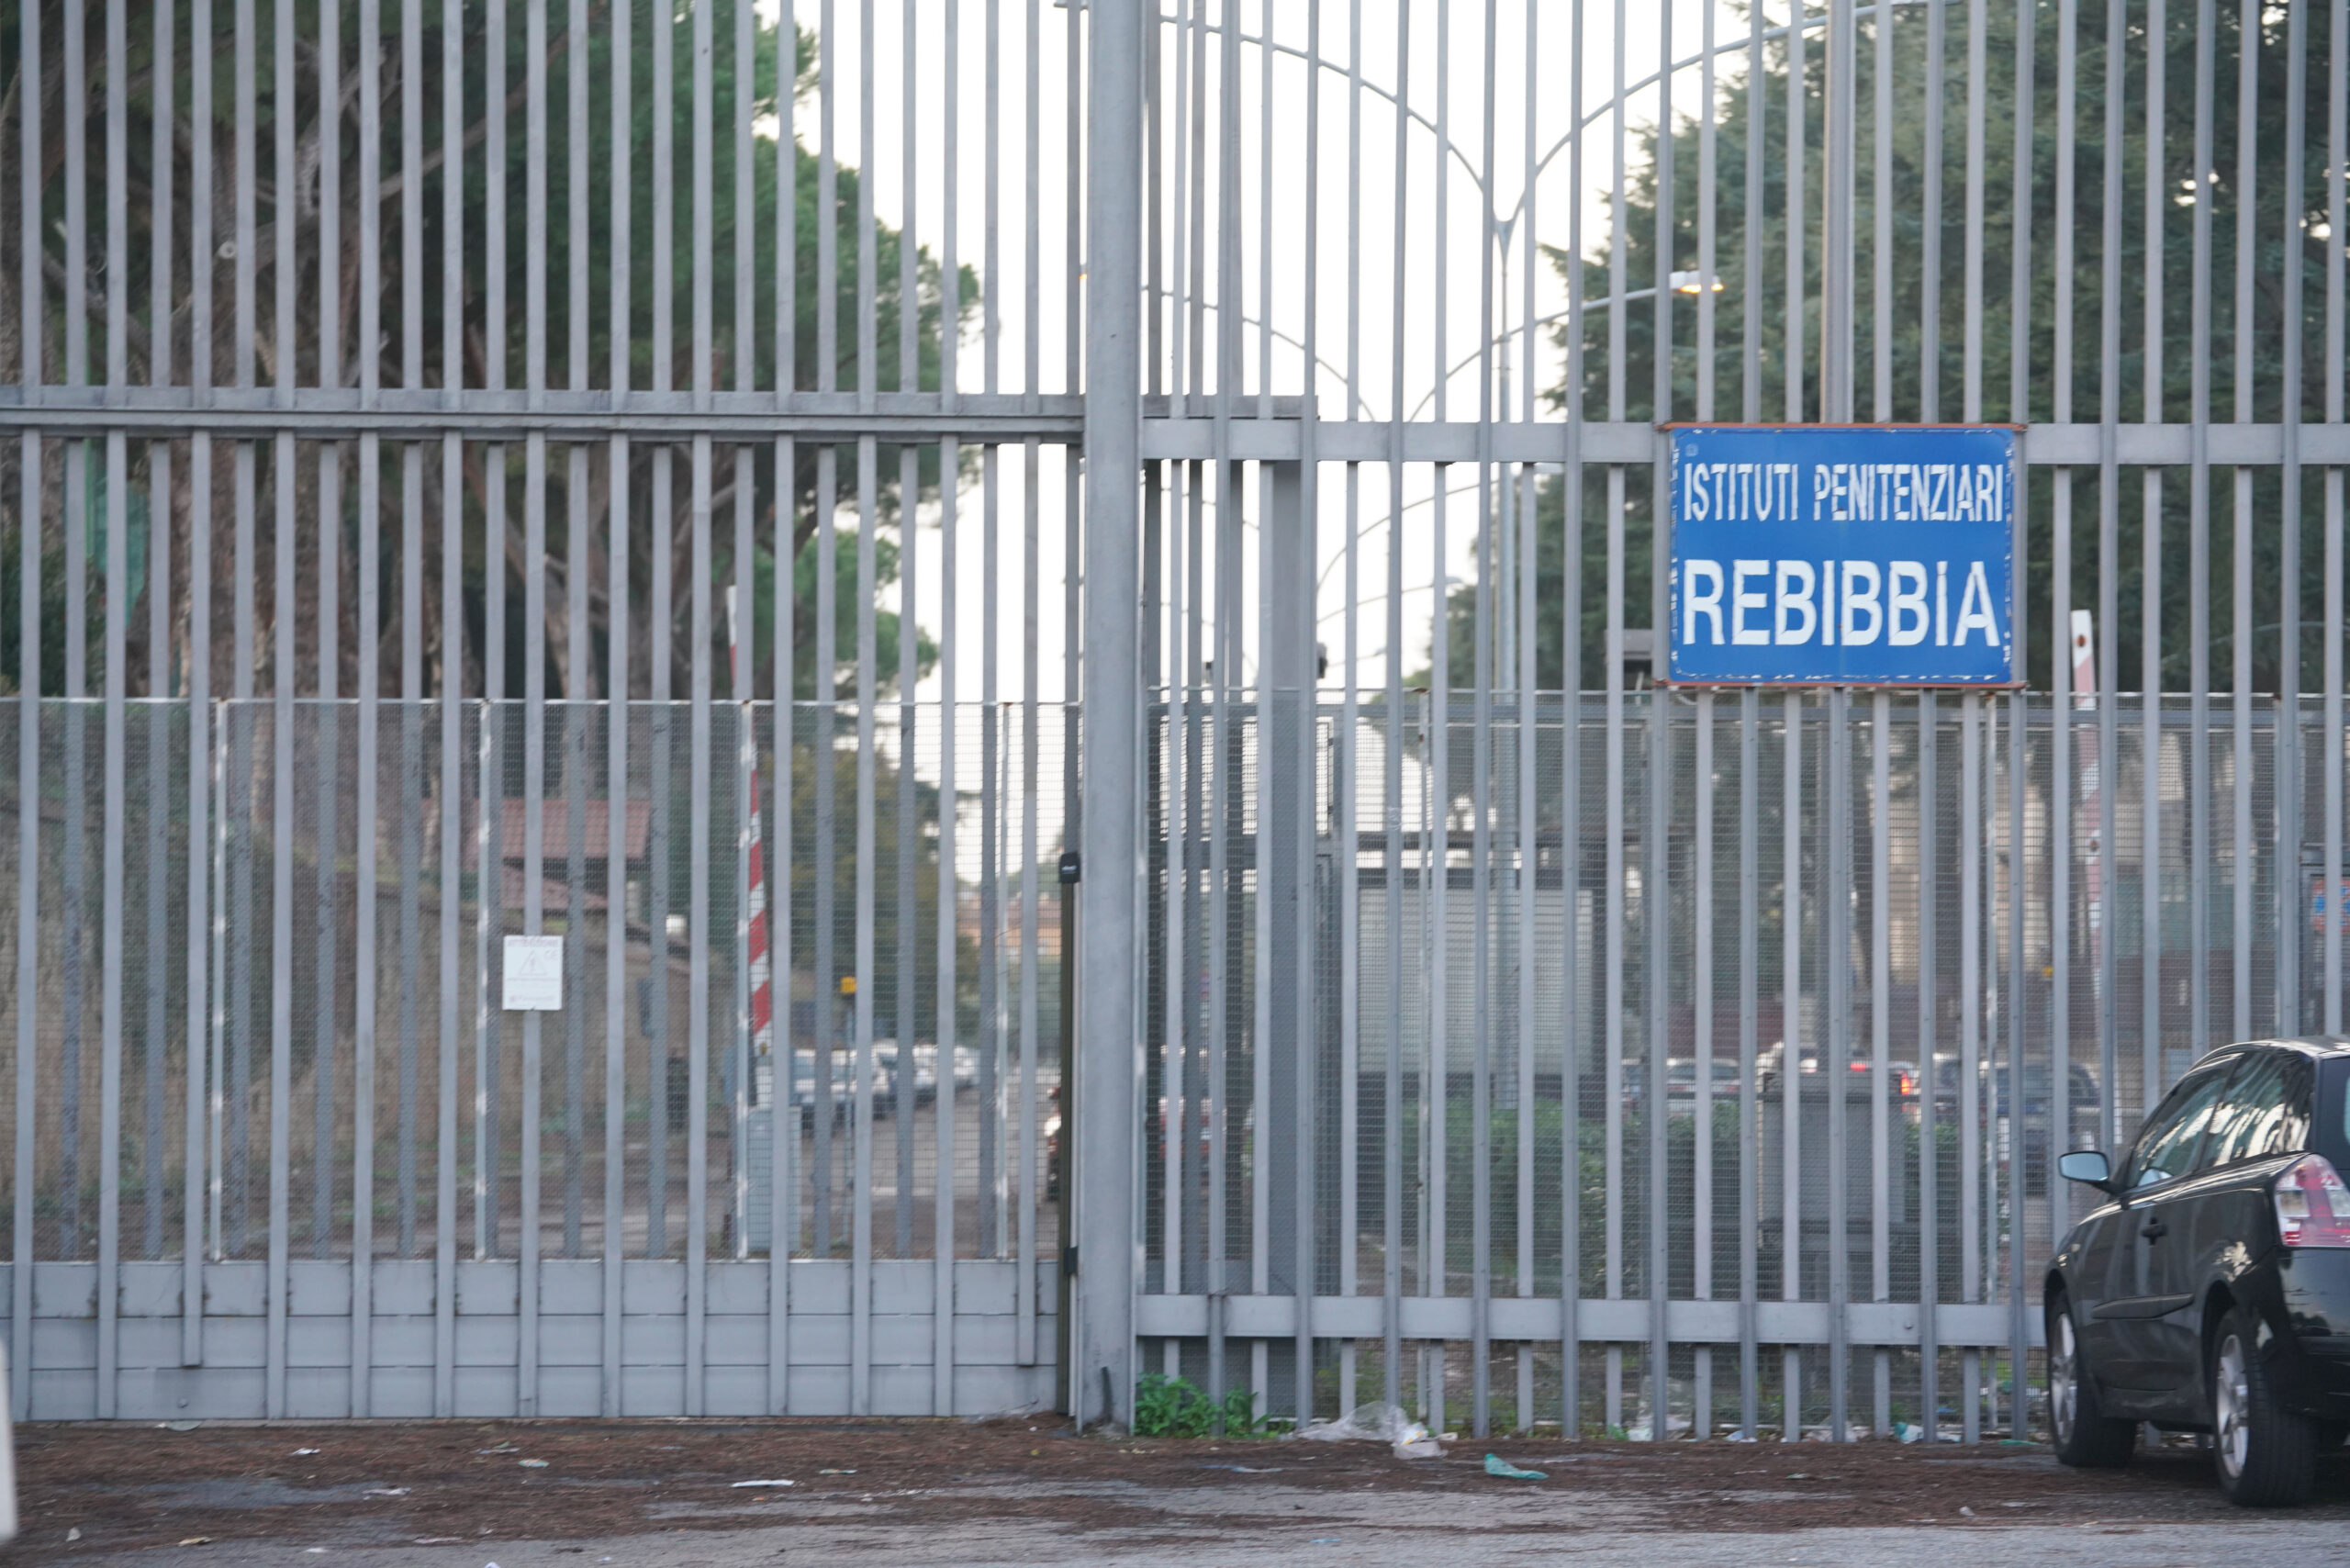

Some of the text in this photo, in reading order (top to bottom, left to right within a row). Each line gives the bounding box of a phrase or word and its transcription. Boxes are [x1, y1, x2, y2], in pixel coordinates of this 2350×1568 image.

[1684, 463, 2003, 522] ISTITUTI PENITENZIARI
[1683, 559, 2000, 647] REBIBBIA
